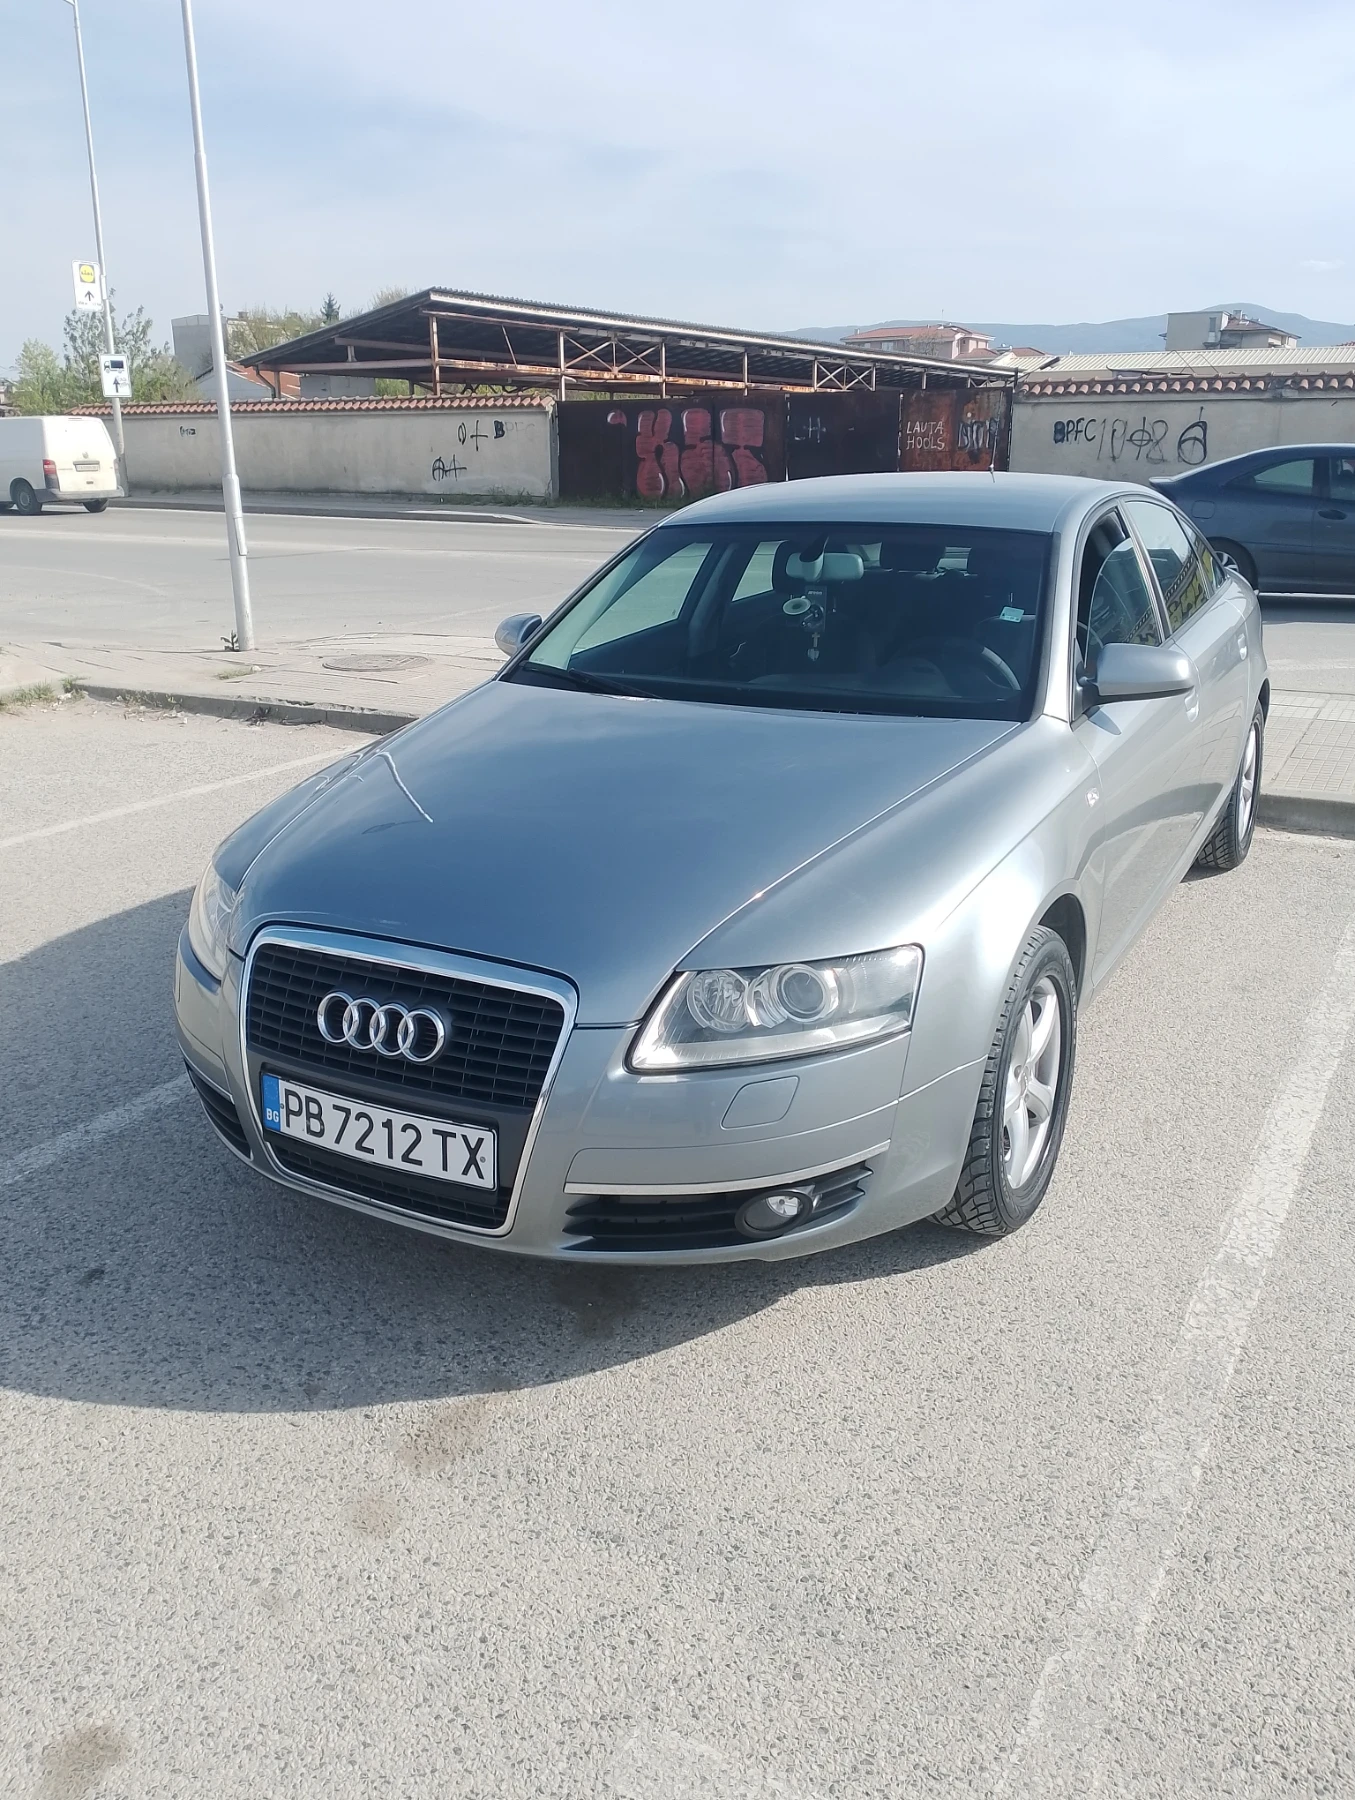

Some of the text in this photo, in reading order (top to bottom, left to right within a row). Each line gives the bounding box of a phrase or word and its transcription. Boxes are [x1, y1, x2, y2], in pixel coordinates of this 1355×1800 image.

[906, 420, 944, 435] LAUTA
[906, 434, 946, 451] HOOLS
[265, 1107, 280, 1123] BG
